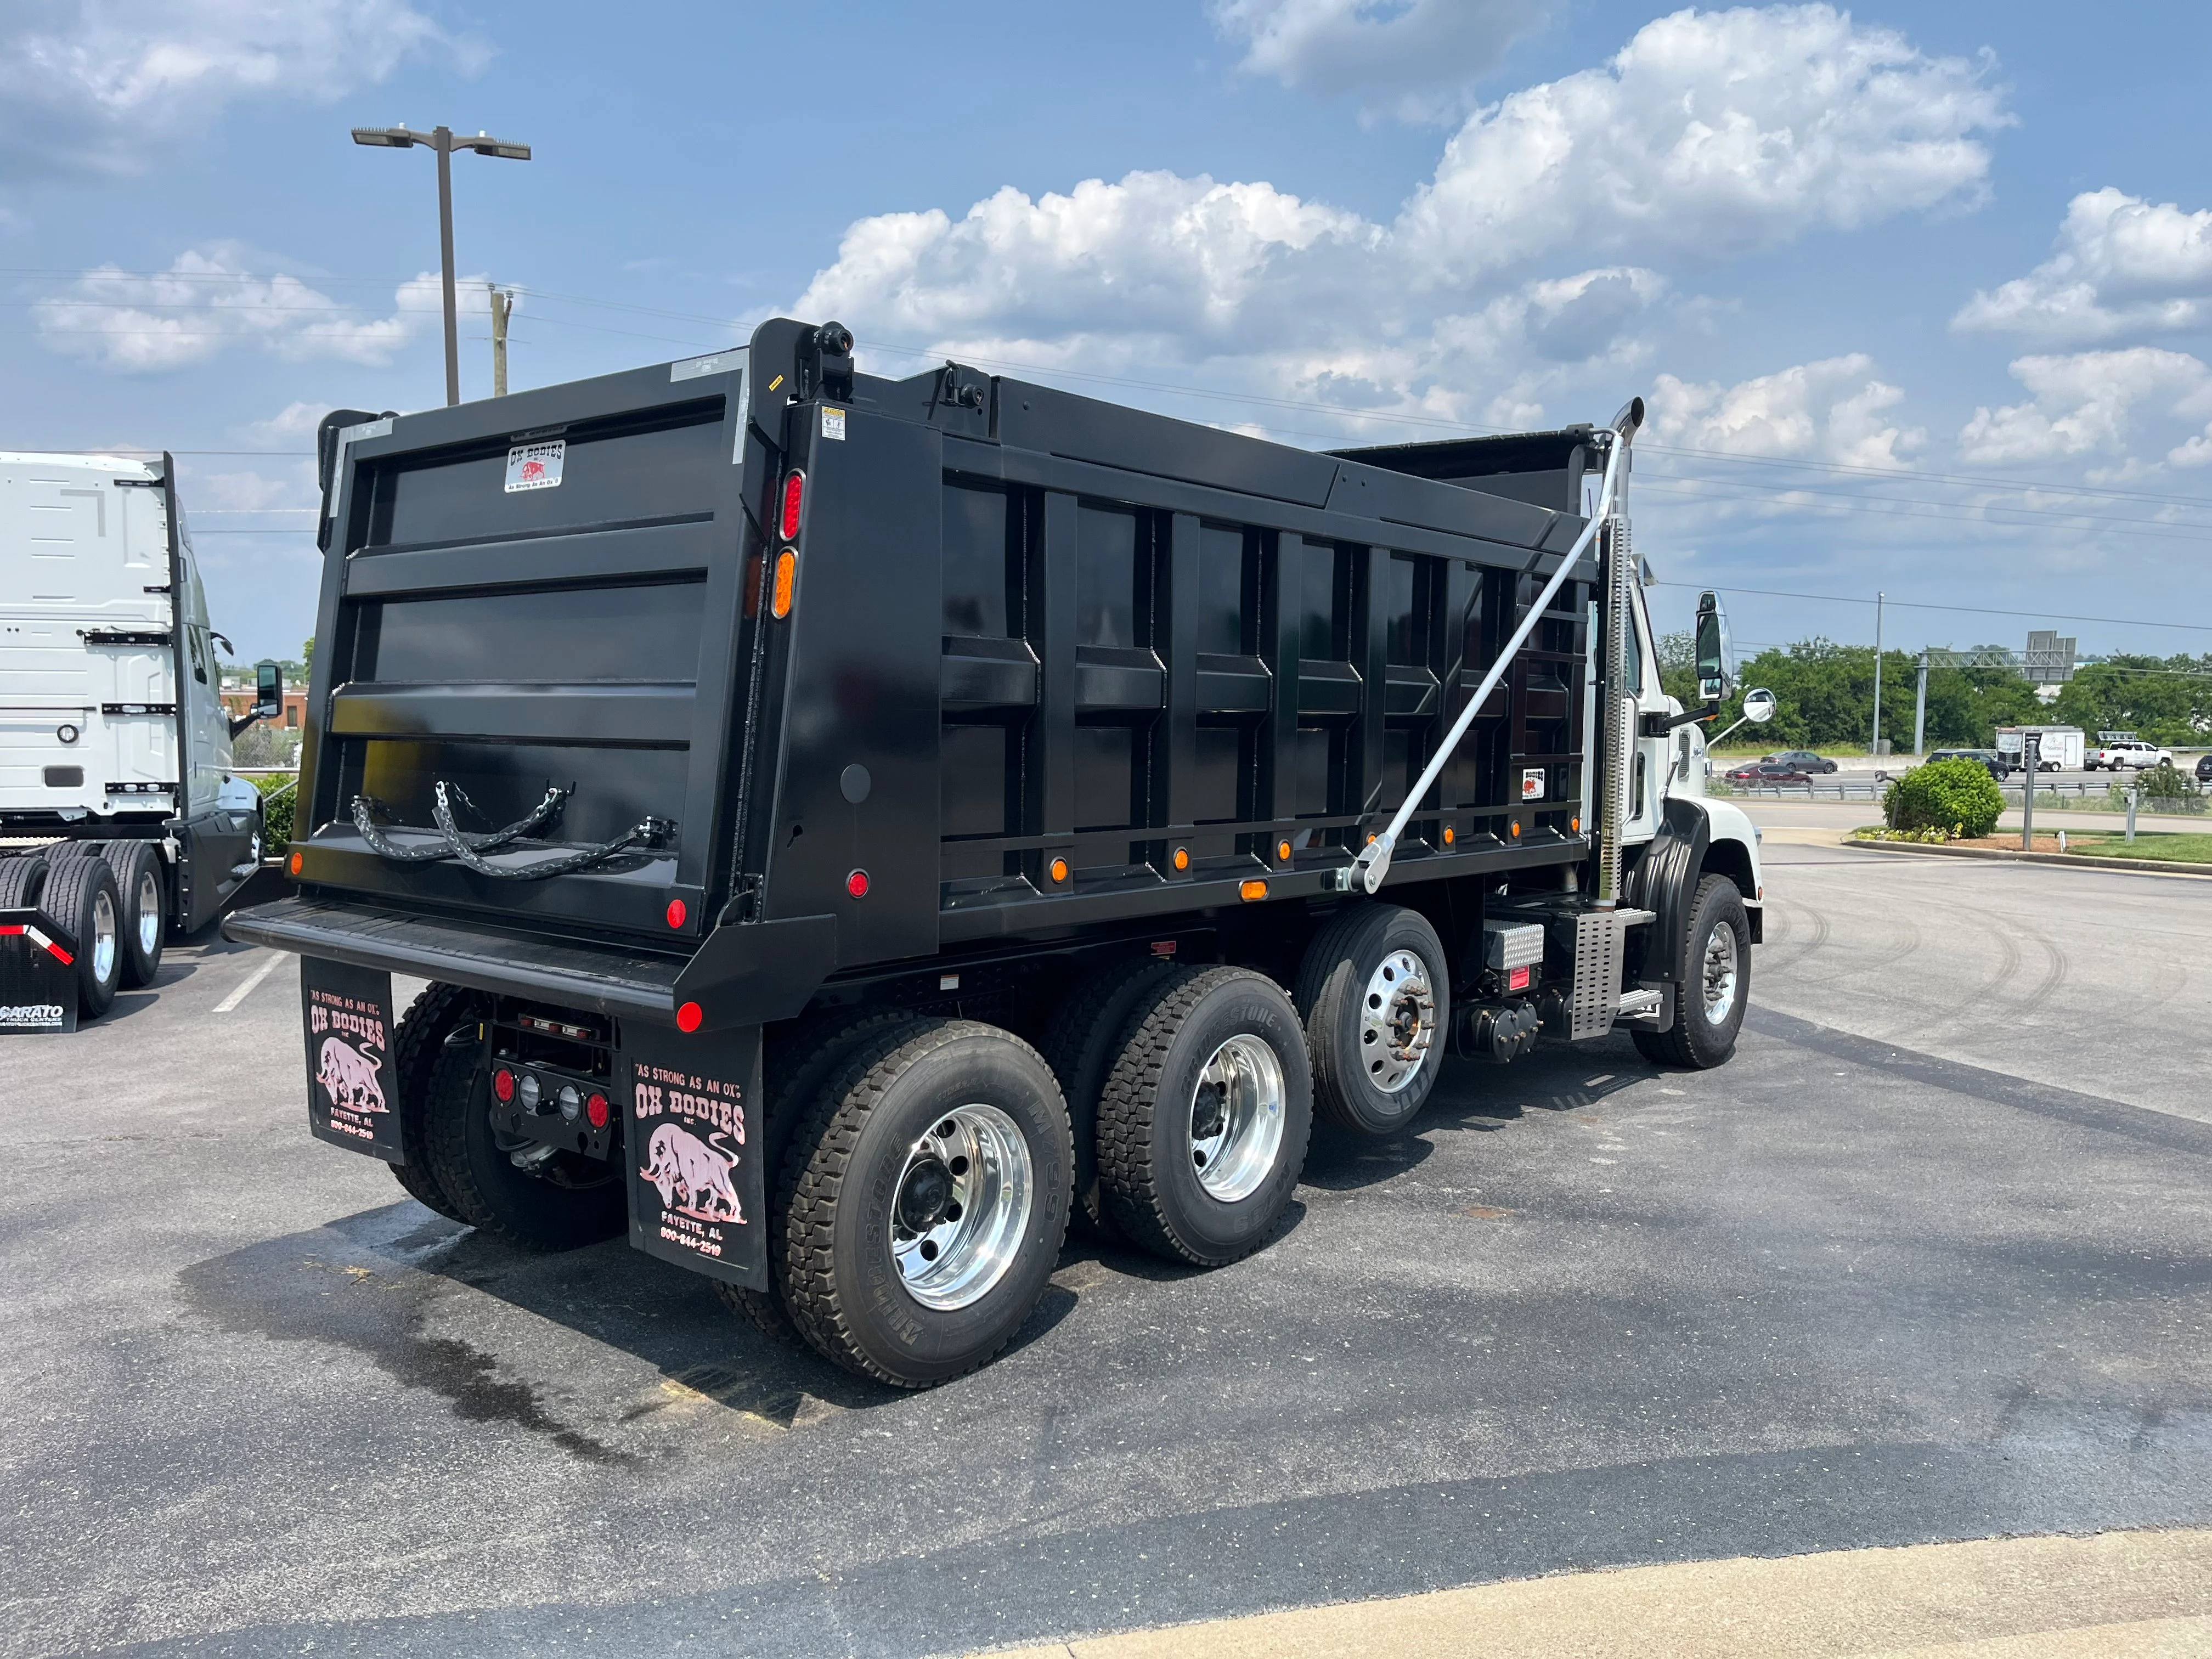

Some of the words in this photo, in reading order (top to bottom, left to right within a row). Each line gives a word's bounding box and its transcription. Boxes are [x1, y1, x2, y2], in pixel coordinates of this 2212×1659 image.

[510, 450, 524, 466] OX
[527, 444, 562, 460] BODIES
[321, 992, 343, 1007] STRONG
[345, 998, 354, 1009] AS
[357, 1001, 366, 1012] AN
[311, 1005, 329, 1034] OX
[331, 1010, 385, 1052] BODIES
[652, 1067, 686, 1086] STRONG
[689, 1075, 702, 1090] AS
[706, 1079, 720, 1094] AN
[330, 1107, 362, 1126] FAYETTE,
[364, 1117, 374, 1127] AL
[635, 1082, 663, 1119] OX
[669, 1090, 746, 1146] BODIES
[330, 1119, 374, 1140] 800-844-2519
[661, 1210, 705, 1238] FAYETTE,
[708, 1227, 723, 1242] AL
[865, 1132, 927, 1347] BRIDGESTONE
[661, 1227, 721, 1256] 800-844-2519
